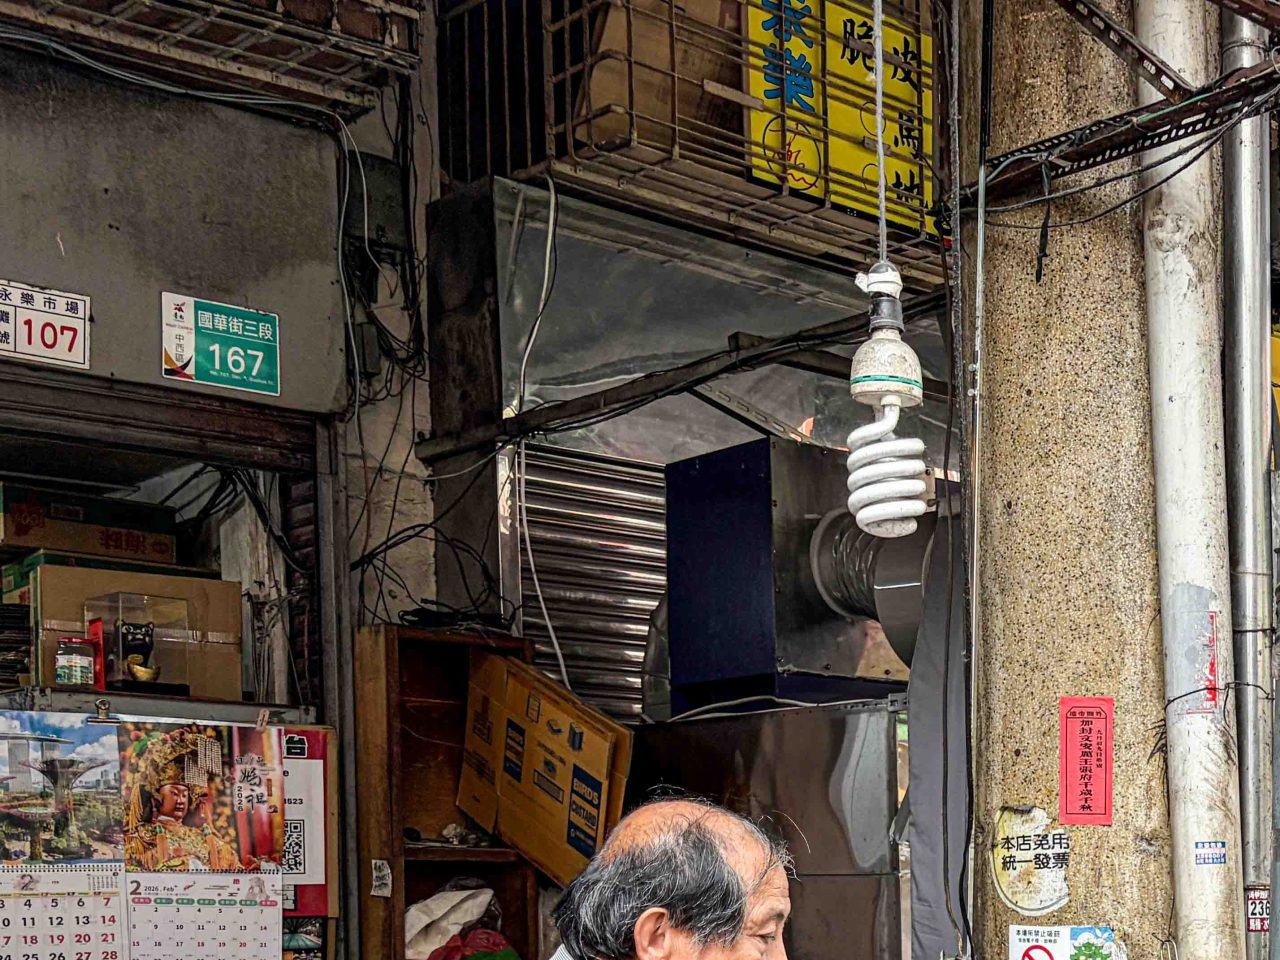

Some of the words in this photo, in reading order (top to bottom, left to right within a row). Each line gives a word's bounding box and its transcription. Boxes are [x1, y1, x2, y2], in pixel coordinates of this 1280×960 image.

[0, 287, 79, 315] 永樂市場
[198, 310, 273, 341] 國華街三段
[23, 318, 78, 353] 107
[209, 343, 265, 377] 167
[1001, 852, 1070, 871] 統一發票
[129, 880, 142, 896] 2
[24, 899, 32, 909] 4
[51, 898, 59, 908] 5
[77, 898, 85, 907] 6
[103, 897, 111, 906] 7
[21, 917, 36, 926] 11
[48, 916, 64, 926] 12
[75, 915, 90, 925] 13
[101, 915, 116, 924] 14
[22, 935, 38, 945] 18
[49, 934, 65, 944] 19
[75, 934, 91, 943] 20
[101, 933, 115, 942] 21
[75, 951, 92, 960] 27
[102, 951, 118, 960] 28
